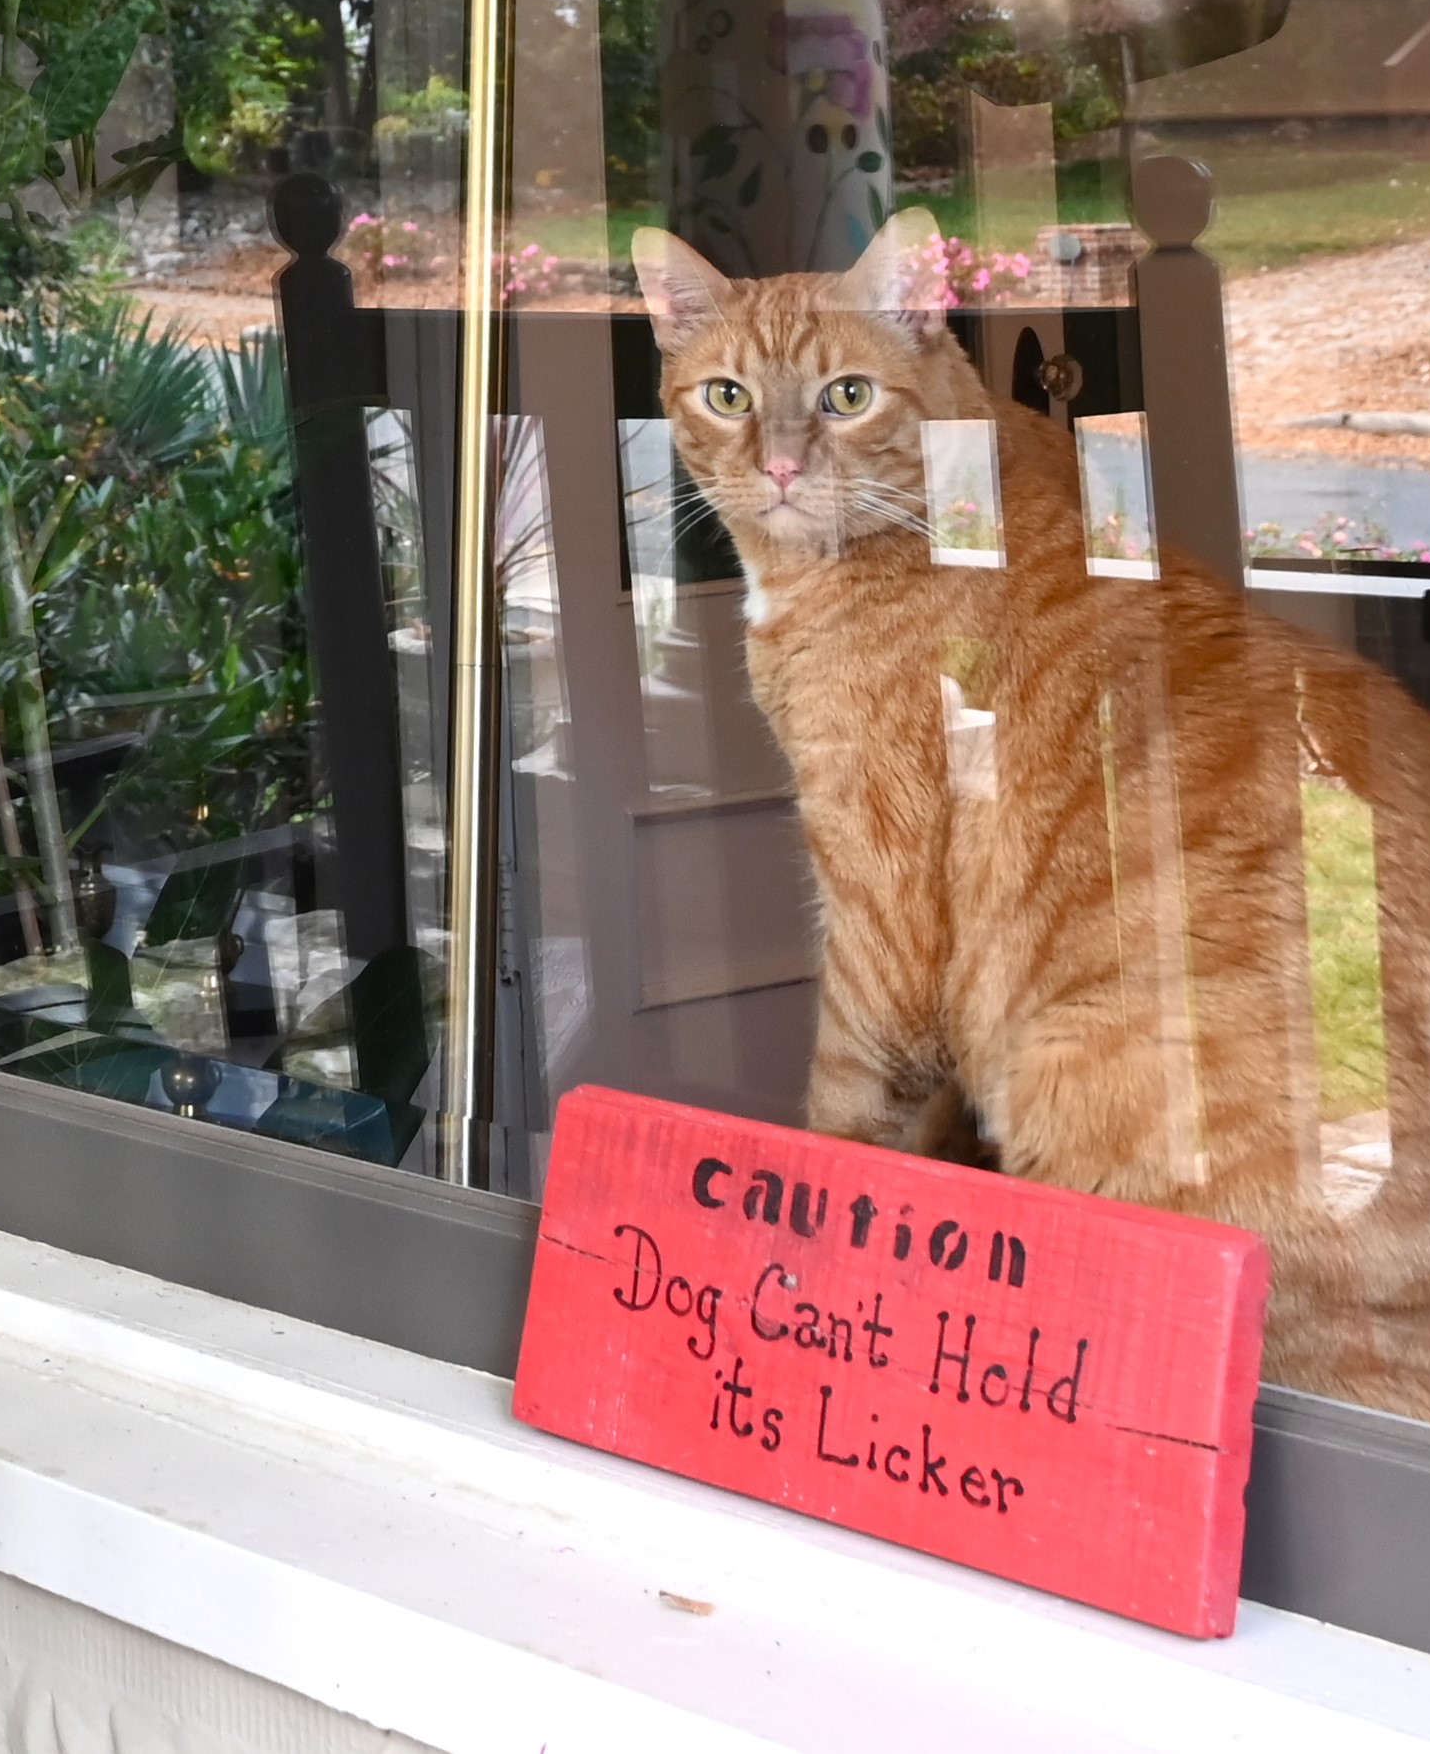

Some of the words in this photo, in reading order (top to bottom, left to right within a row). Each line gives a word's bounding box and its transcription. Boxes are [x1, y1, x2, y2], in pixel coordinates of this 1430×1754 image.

[692, 1157, 1027, 1287] caution
[614, 1225, 722, 1360] Dog
[749, 1264, 894, 1369] Can't
[929, 1312, 1089, 1424] Hold
[710, 1357, 783, 1452] its
[817, 1385, 1025, 1514] Licker
